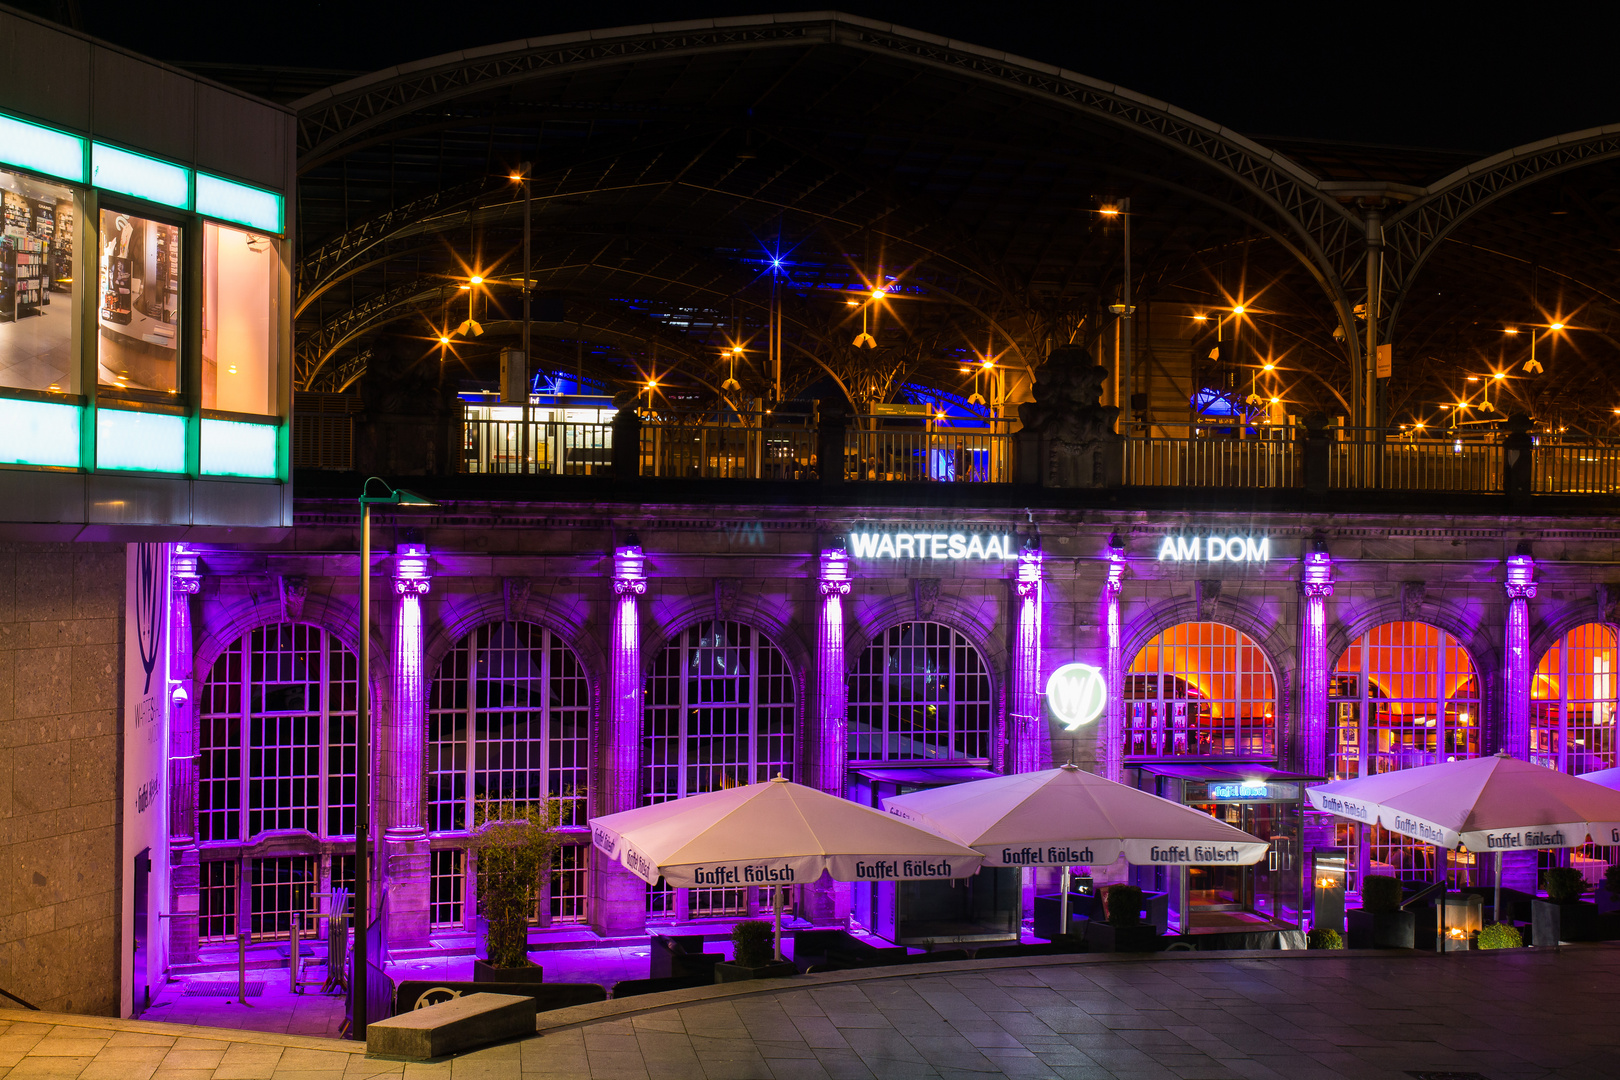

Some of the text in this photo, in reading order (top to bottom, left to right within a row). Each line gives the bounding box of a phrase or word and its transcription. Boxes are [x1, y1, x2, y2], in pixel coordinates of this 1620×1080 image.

[850, 533, 1270, 562] WARTESAAL AM DOM
[1322, 795, 1367, 820] Gaffel Kölsch
[1395, 815, 1444, 844] Gaffel Kölsch
[1487, 830, 1566, 848] Gaffel Kölsch
[1002, 846, 1094, 865] Gaffel Kölsch
[1150, 845, 1239, 863] Gaffel Kölsch
[694, 863, 794, 885] Gaffel Kölsch
[856, 859, 951, 879] Gaffel Kölsch
